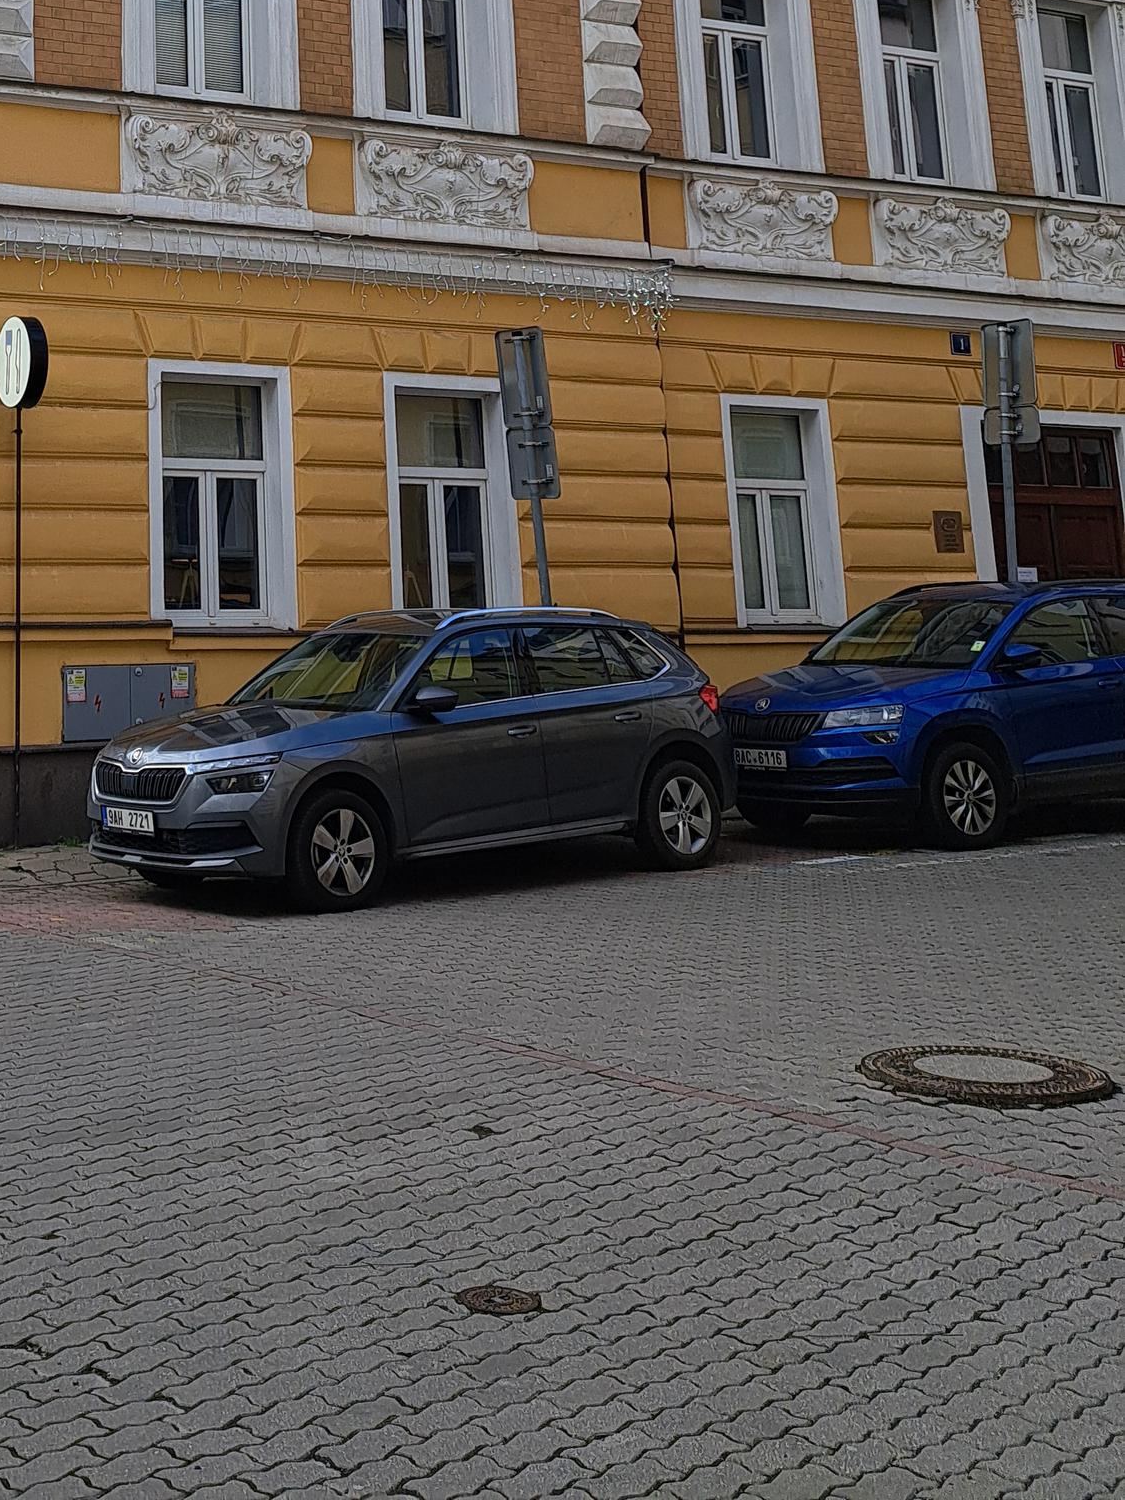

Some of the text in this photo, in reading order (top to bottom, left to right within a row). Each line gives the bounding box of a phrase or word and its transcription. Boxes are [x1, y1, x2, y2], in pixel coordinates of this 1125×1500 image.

[735, 750, 783, 766] 8AC 6116
[108, 809, 150, 830] 9AH 2721
